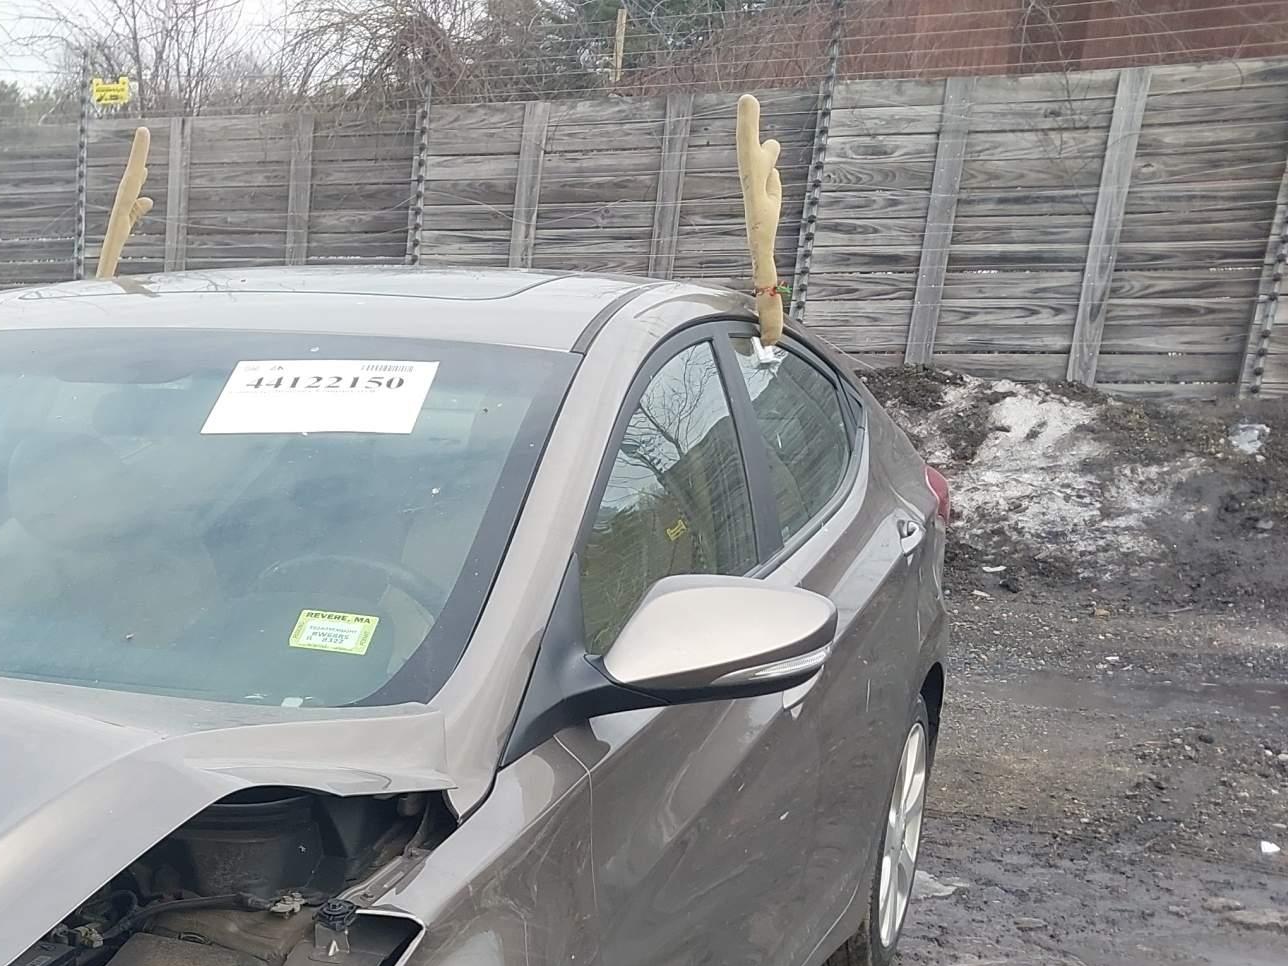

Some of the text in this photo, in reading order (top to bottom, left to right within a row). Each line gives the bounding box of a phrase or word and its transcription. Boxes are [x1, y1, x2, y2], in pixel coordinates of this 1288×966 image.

[246, 376, 405, 389] 44122150
[306, 611, 371, 624] REVERE, MA
